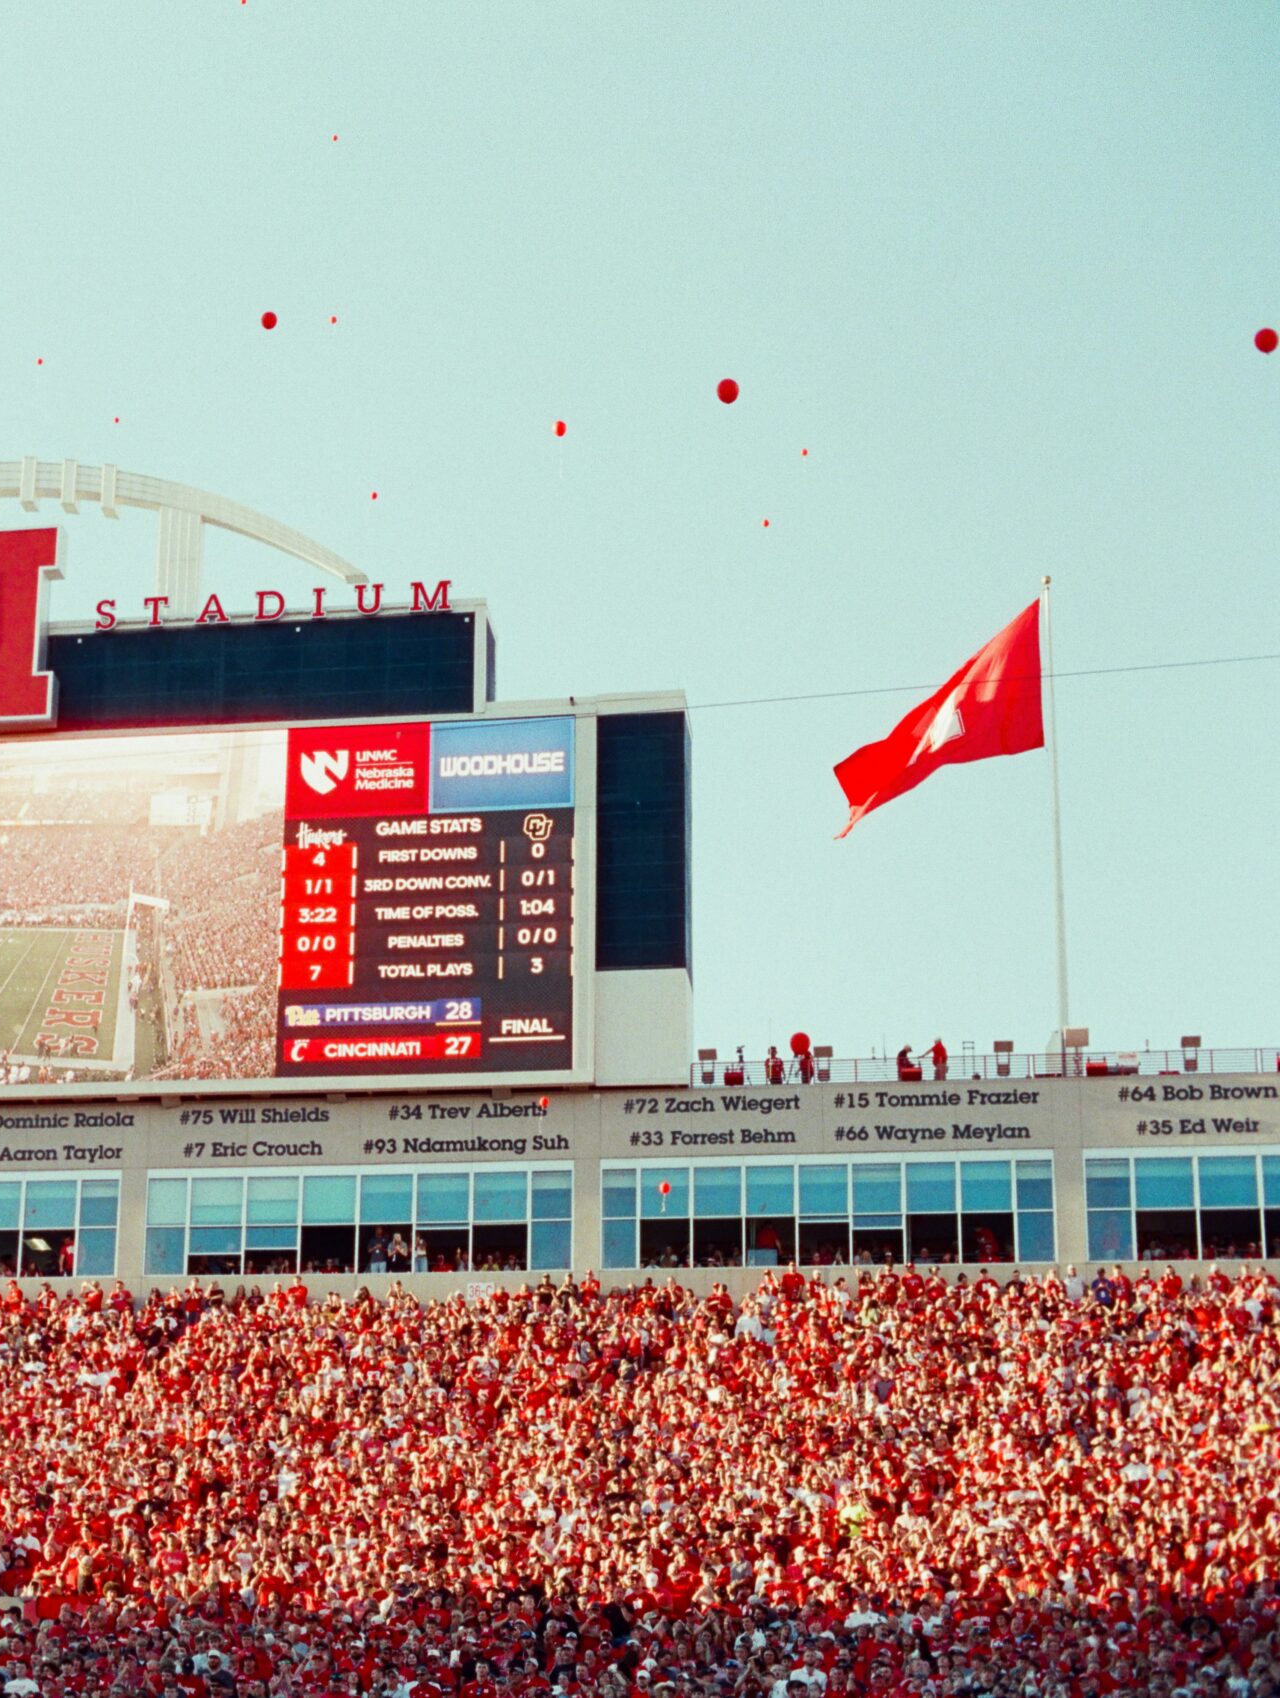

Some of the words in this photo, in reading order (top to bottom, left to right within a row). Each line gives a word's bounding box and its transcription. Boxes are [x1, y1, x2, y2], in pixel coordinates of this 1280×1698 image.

[95, 580, 452, 631] STADIUM
[355, 749, 397, 762] UNMC
[440, 751, 565, 778] WOODHOUSE
[355, 767, 414, 779] Nebraska
[355, 778, 415, 791] Medicine
[376, 820, 428, 837] GAME
[430, 817, 482, 834] STATS
[312, 851, 326, 867] 4
[378, 849, 418, 863] FIRST
[420, 846, 478, 862] DOWNS
[531, 842, 545, 859] 0
[364, 878, 392, 893] 3RD
[395, 876, 444, 892] DOWN
[446, 874, 492, 890] CONV.
[298, 907, 337, 923] 3:22
[375, 906, 410, 921] TIME
[412, 905, 433, 919] OF
[434, 903, 479, 919] POSS.
[520, 898, 556, 916] 1:04
[388, 932, 464, 949] PENALTIES
[310, 964, 322, 981] 7
[378, 963, 424, 979] TOTAL
[426, 962, 473, 978] PLAYS
[531, 957, 544, 974] 3
[325, 1005, 432, 1022] PITTSBURGH
[445, 1001, 472, 1020] 28
[501, 1018, 553, 1035] FINAL
[324, 1041, 422, 1058] CINCINNATI
[445, 1037, 472, 1055] 27
[833, 1092, 870, 1109] #15
[875, 1090, 961, 1108] Tommie
[966, 1087, 1040, 1106] Frazier
[1118, 1085, 1157, 1102] #64
[1162, 1084, 1204, 1101] Bob
[1209, 1083, 1280, 1100] Brown
[388, 1104, 423, 1120] #34
[428, 1103, 471, 1119] Trev
[476, 1101, 548, 1118] Alberts
[623, 1098, 659, 1114] #72
[664, 1096, 716, 1113] Zach
[720, 1093, 801, 1115] Wiegert
[73, 1111, 135, 1128] Raiola
[179, 1109, 214, 1125] #75
[220, 1108, 256, 1124] Will
[261, 1106, 330, 1123] Shields
[834, 1125, 869, 1142] #66
[875, 1124, 947, 1144] Wayne
[951, 1122, 1031, 1143] Meylan
[1136, 1119, 1174, 1136] #35
[1179, 1118, 1207, 1135] Ed
[1211, 1116, 1260, 1135] Weir
[362, 1138, 397, 1154] #93
[402, 1137, 528, 1155] Ndamukong
[532, 1134, 570, 1151] Suh
[629, 1130, 664, 1147] #33
[670, 1129, 735, 1146] Forrest
[740, 1128, 796, 1145] Behm
[63, 1144, 123, 1164] Taylor
[183, 1142, 205, 1158] #7
[211, 1141, 248, 1157] Eric
[252, 1140, 323, 1157] Crouch
